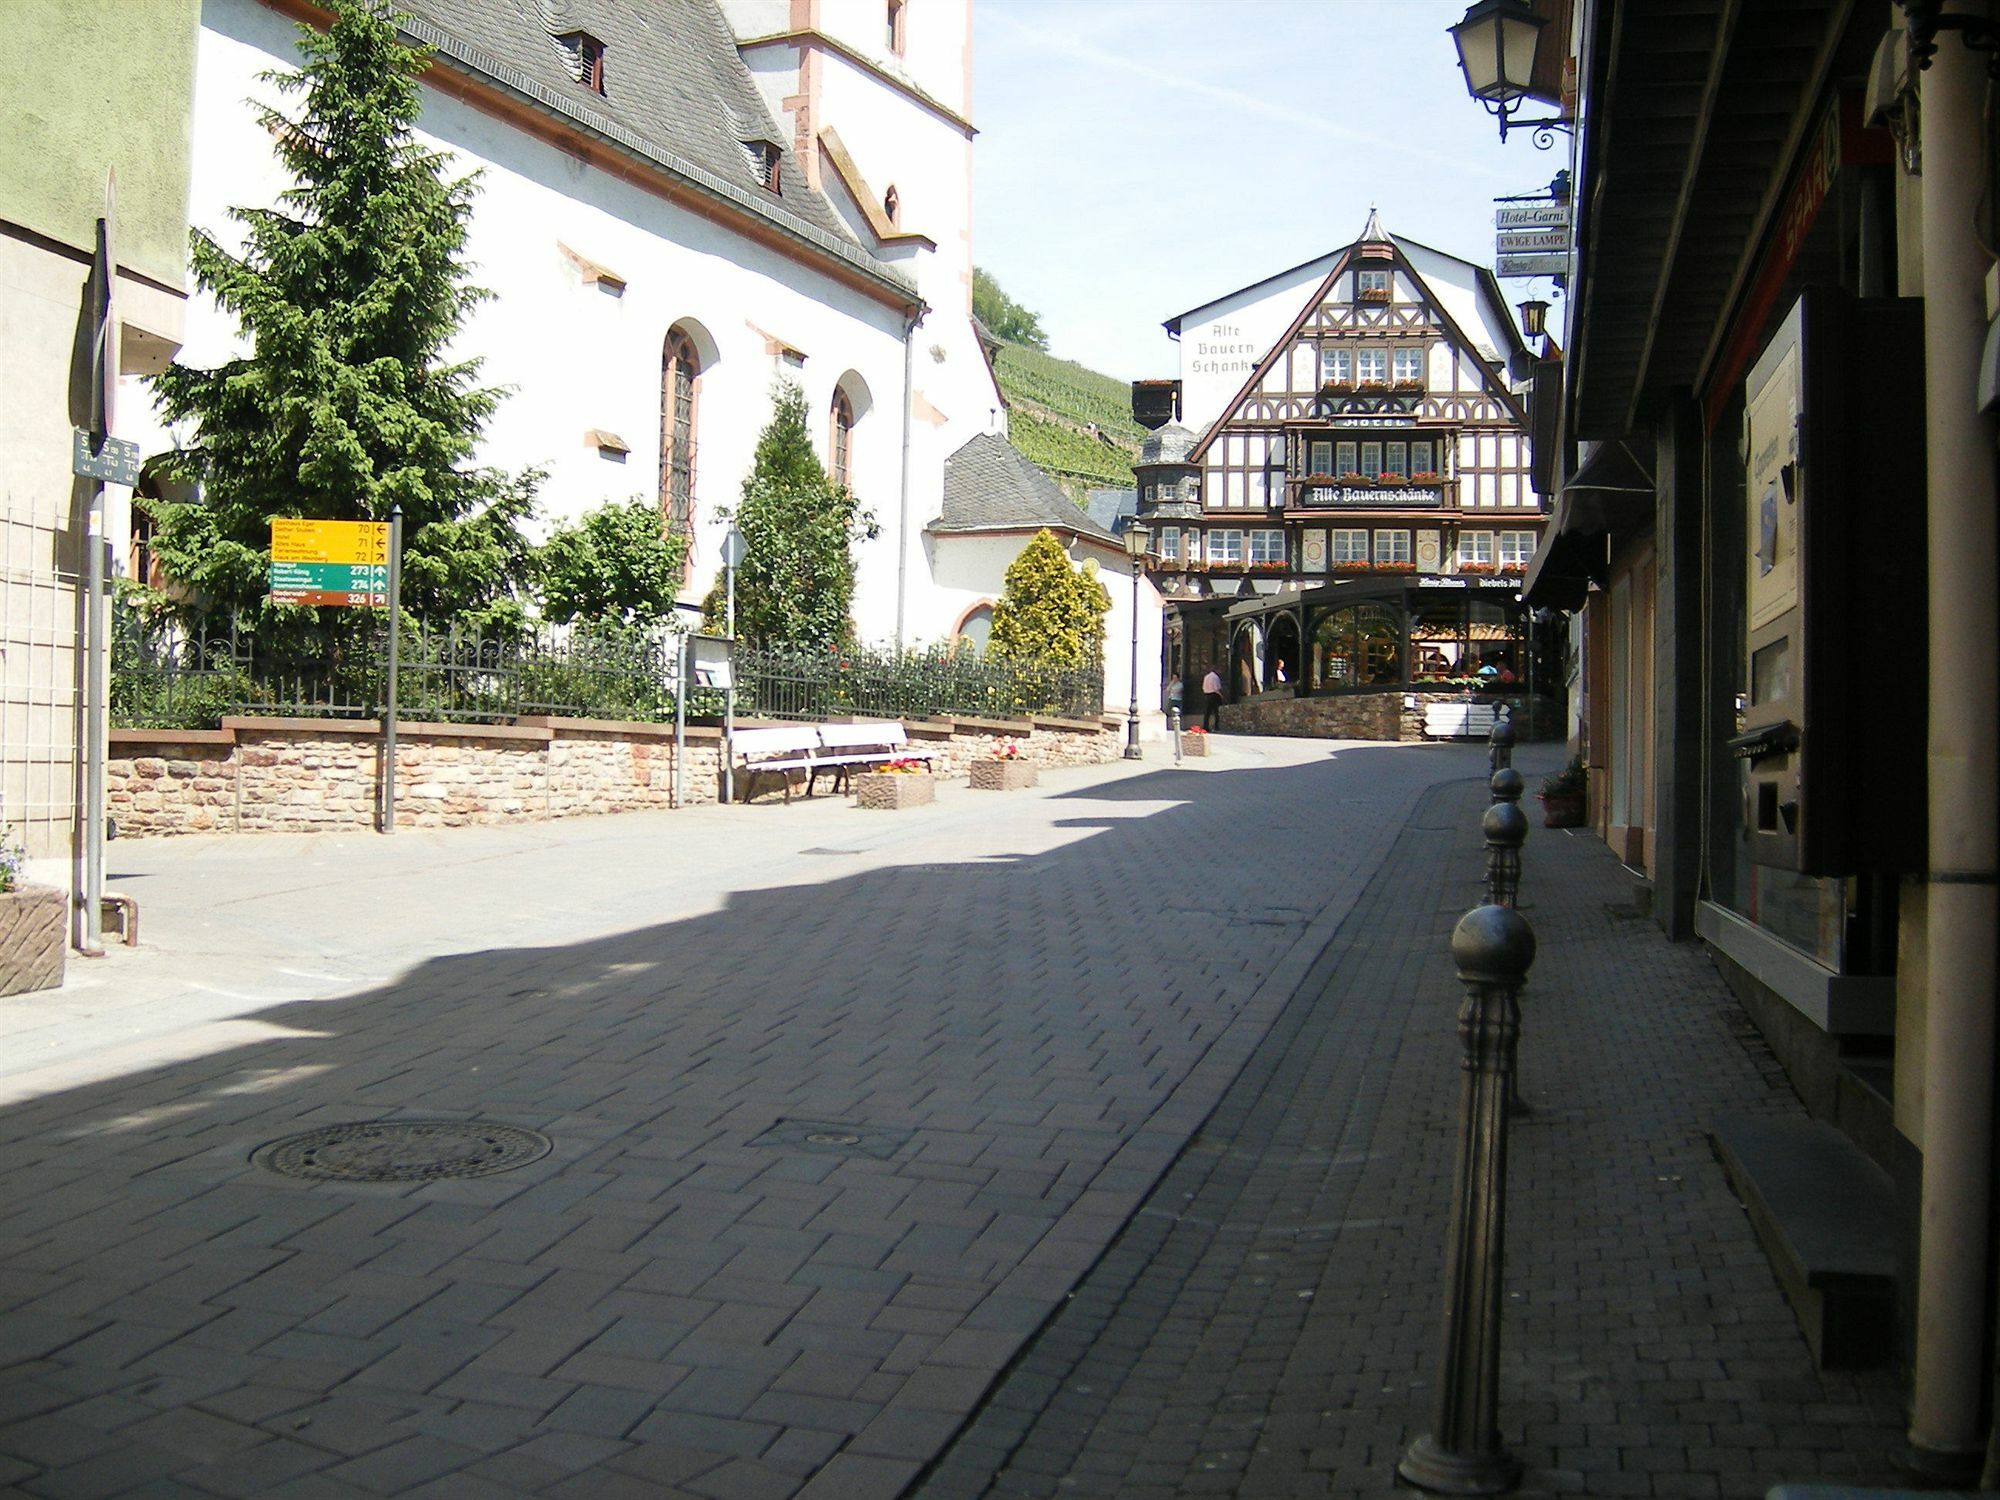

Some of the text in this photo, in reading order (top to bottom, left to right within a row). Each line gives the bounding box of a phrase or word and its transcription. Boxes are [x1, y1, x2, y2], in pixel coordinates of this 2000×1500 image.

[1786, 149, 1823, 262] SPAR
[1500, 209, 1565, 224] Hotel-Garni
[1501, 234, 1566, 247] EWIGE LAMPE
[1212, 324, 1240, 337] Alte
[1198, 342, 1254, 355] Bauern
[1312, 487, 1435, 502] Alte Bauernschänke
[358, 524, 370, 534] 70
[358, 538, 368, 548] 71
[355, 552, 367, 562] 72
[350, 565, 370, 576] 273
[351, 579, 369, 590] 274
[1479, 577, 1508, 588] Diebels
[347, 593, 367, 604] 326
